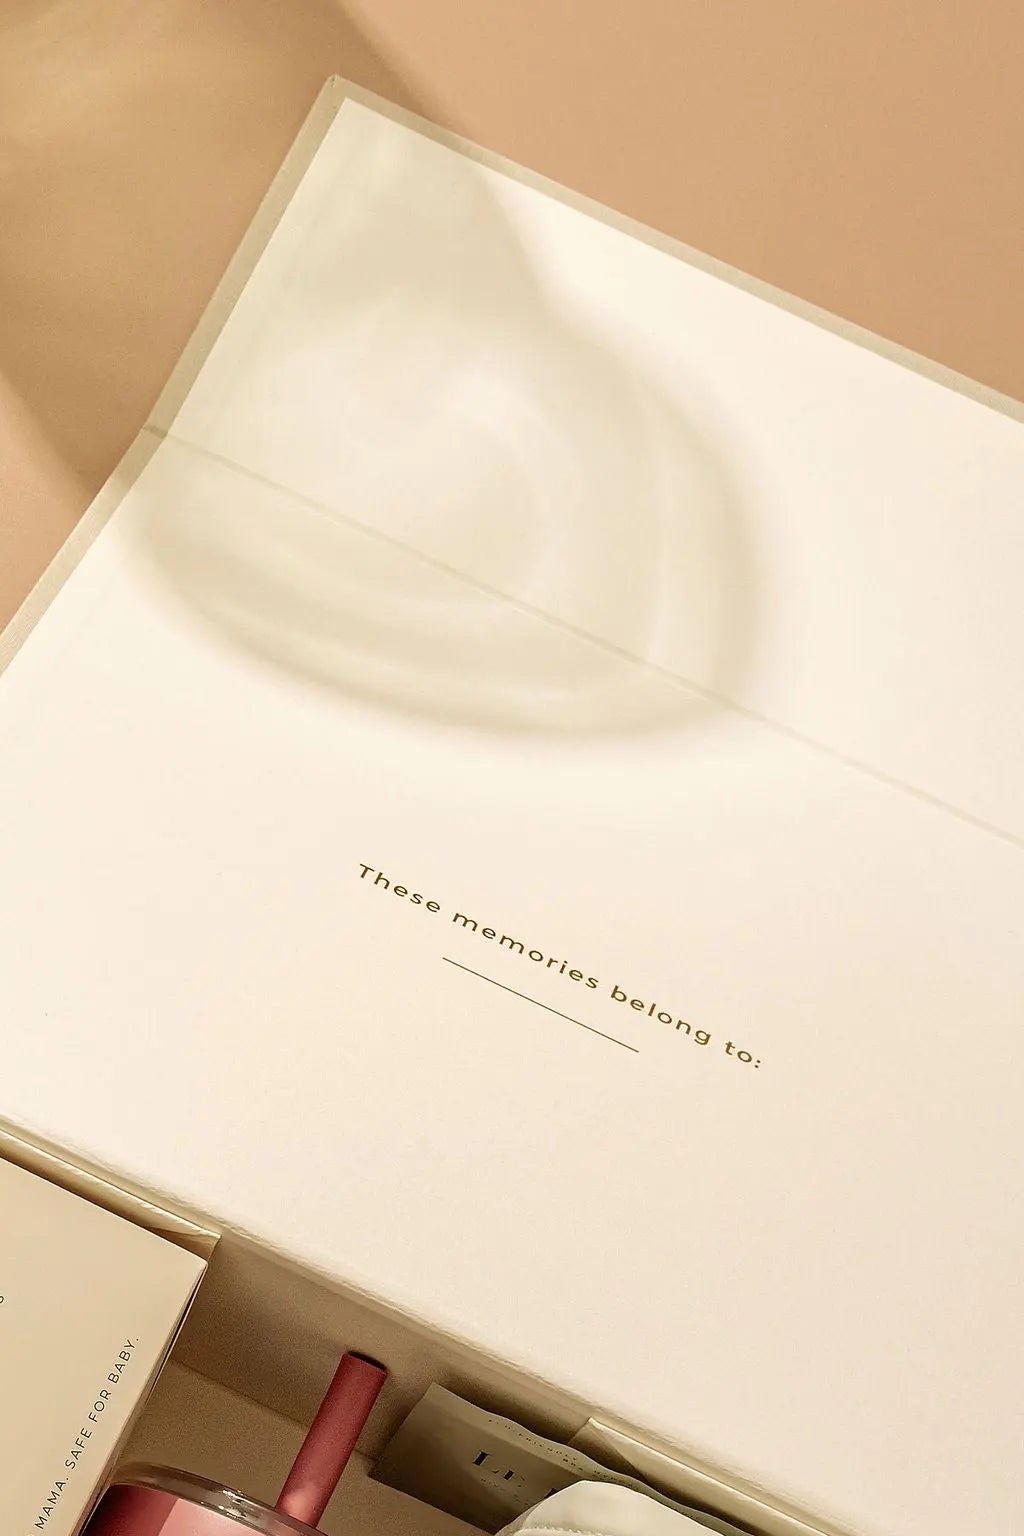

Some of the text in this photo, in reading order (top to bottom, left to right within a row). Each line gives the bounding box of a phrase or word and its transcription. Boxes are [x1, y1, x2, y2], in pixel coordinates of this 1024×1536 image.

[360, 864, 760, 1068] These memories belong to:
[35, 1478, 68, 1529] MAMA.
[65, 1428, 92, 1469] SAFE
[89, 1390, 111, 1422] FOR
[108, 1339, 138, 1383] BABY.
